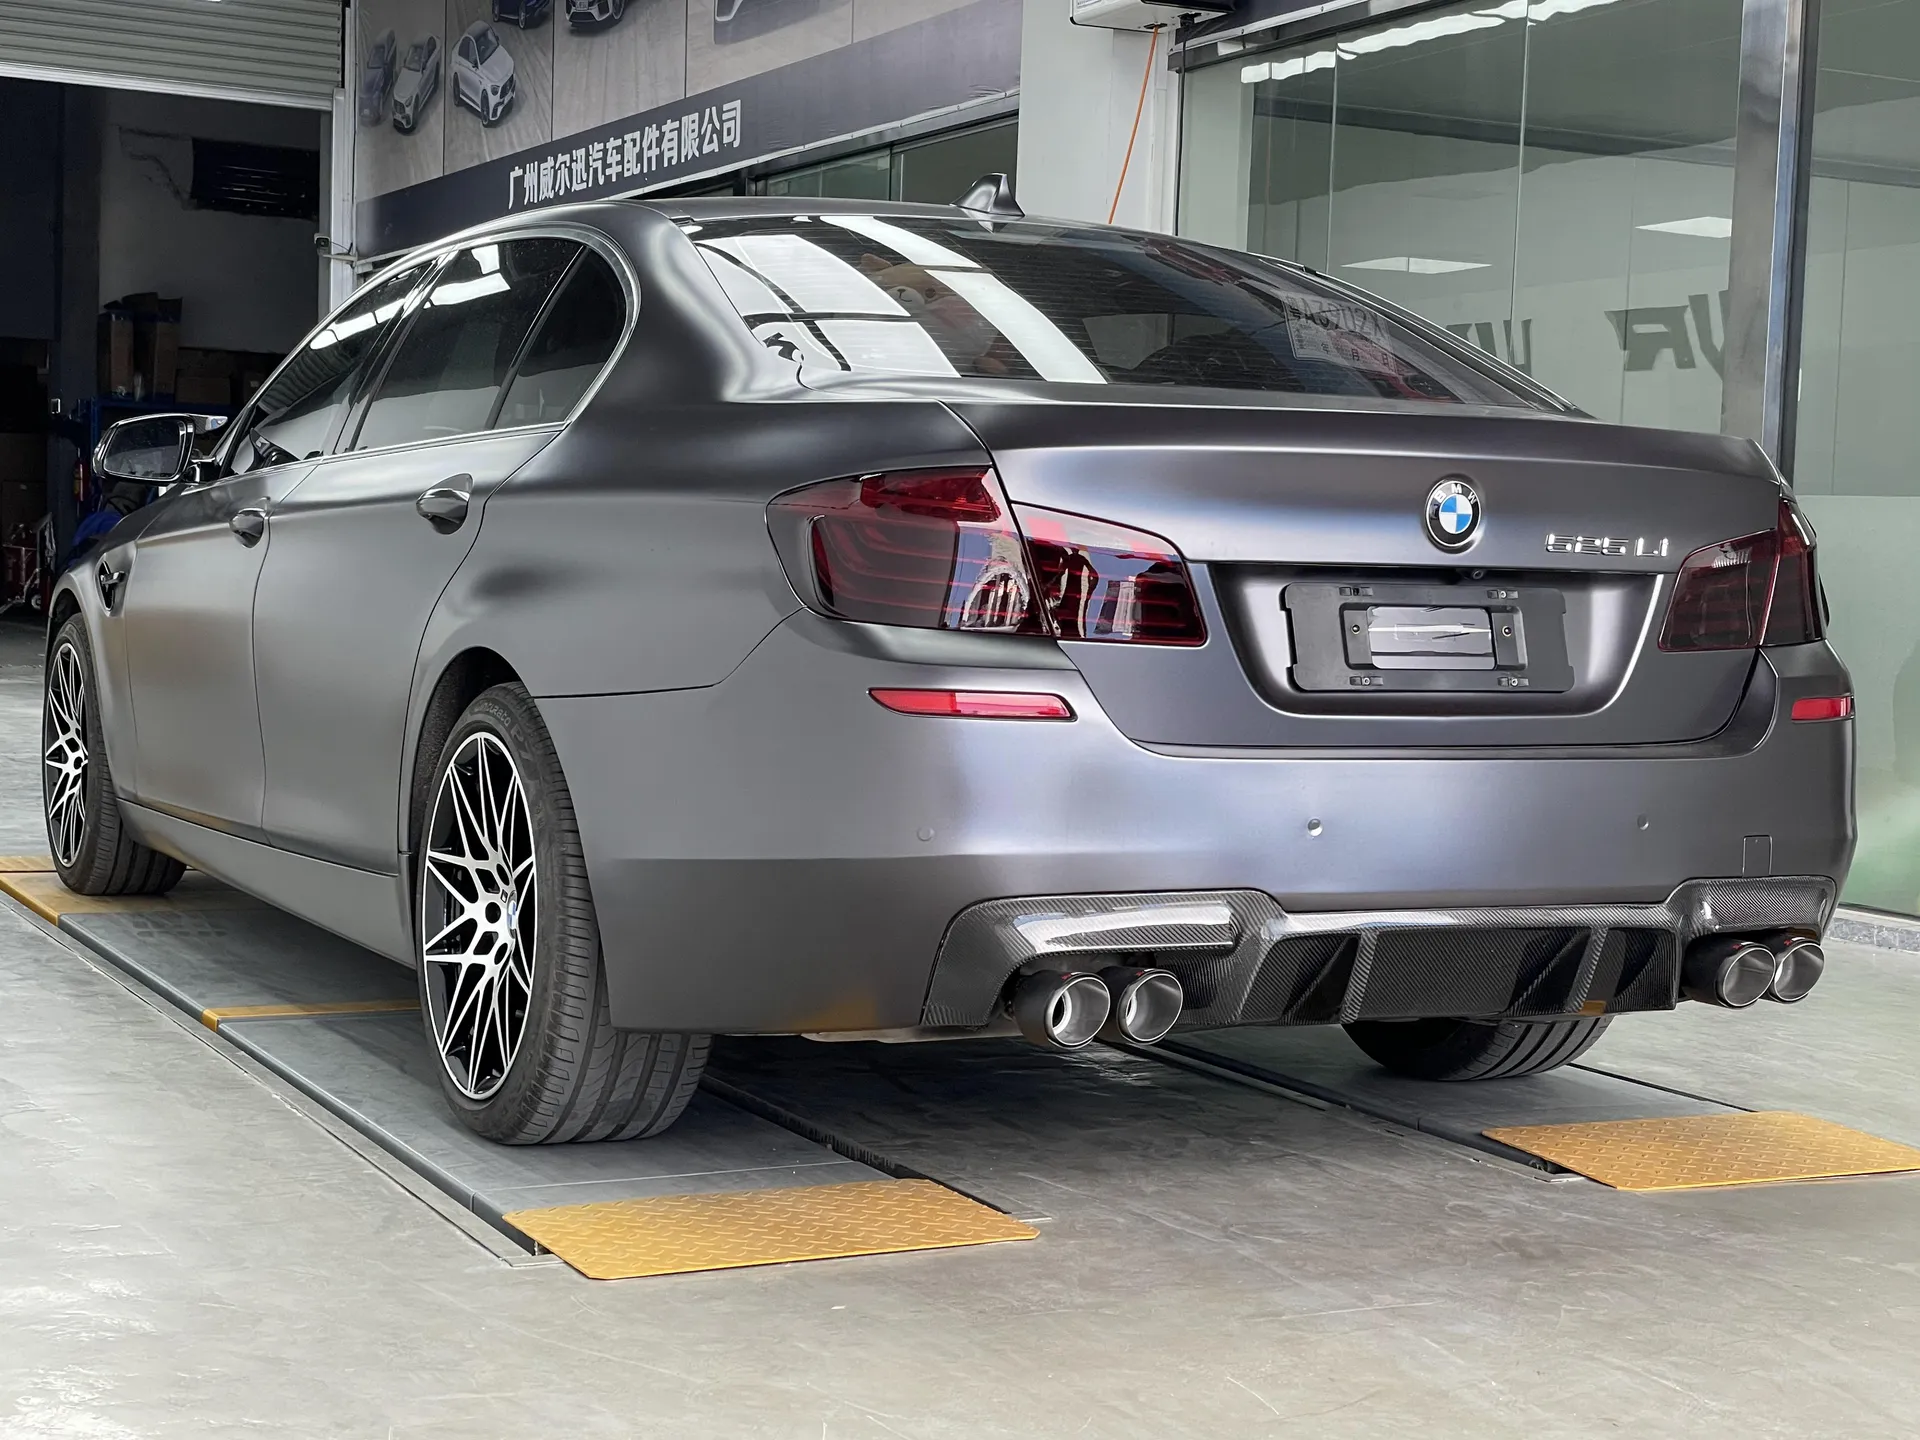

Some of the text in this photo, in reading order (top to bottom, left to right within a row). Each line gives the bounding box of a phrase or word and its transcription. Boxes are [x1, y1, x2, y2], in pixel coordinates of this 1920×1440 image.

[508, 99, 741, 209] 广州威尔迅汽车配件有限公司
[1433, 483, 1478, 504] BMW
